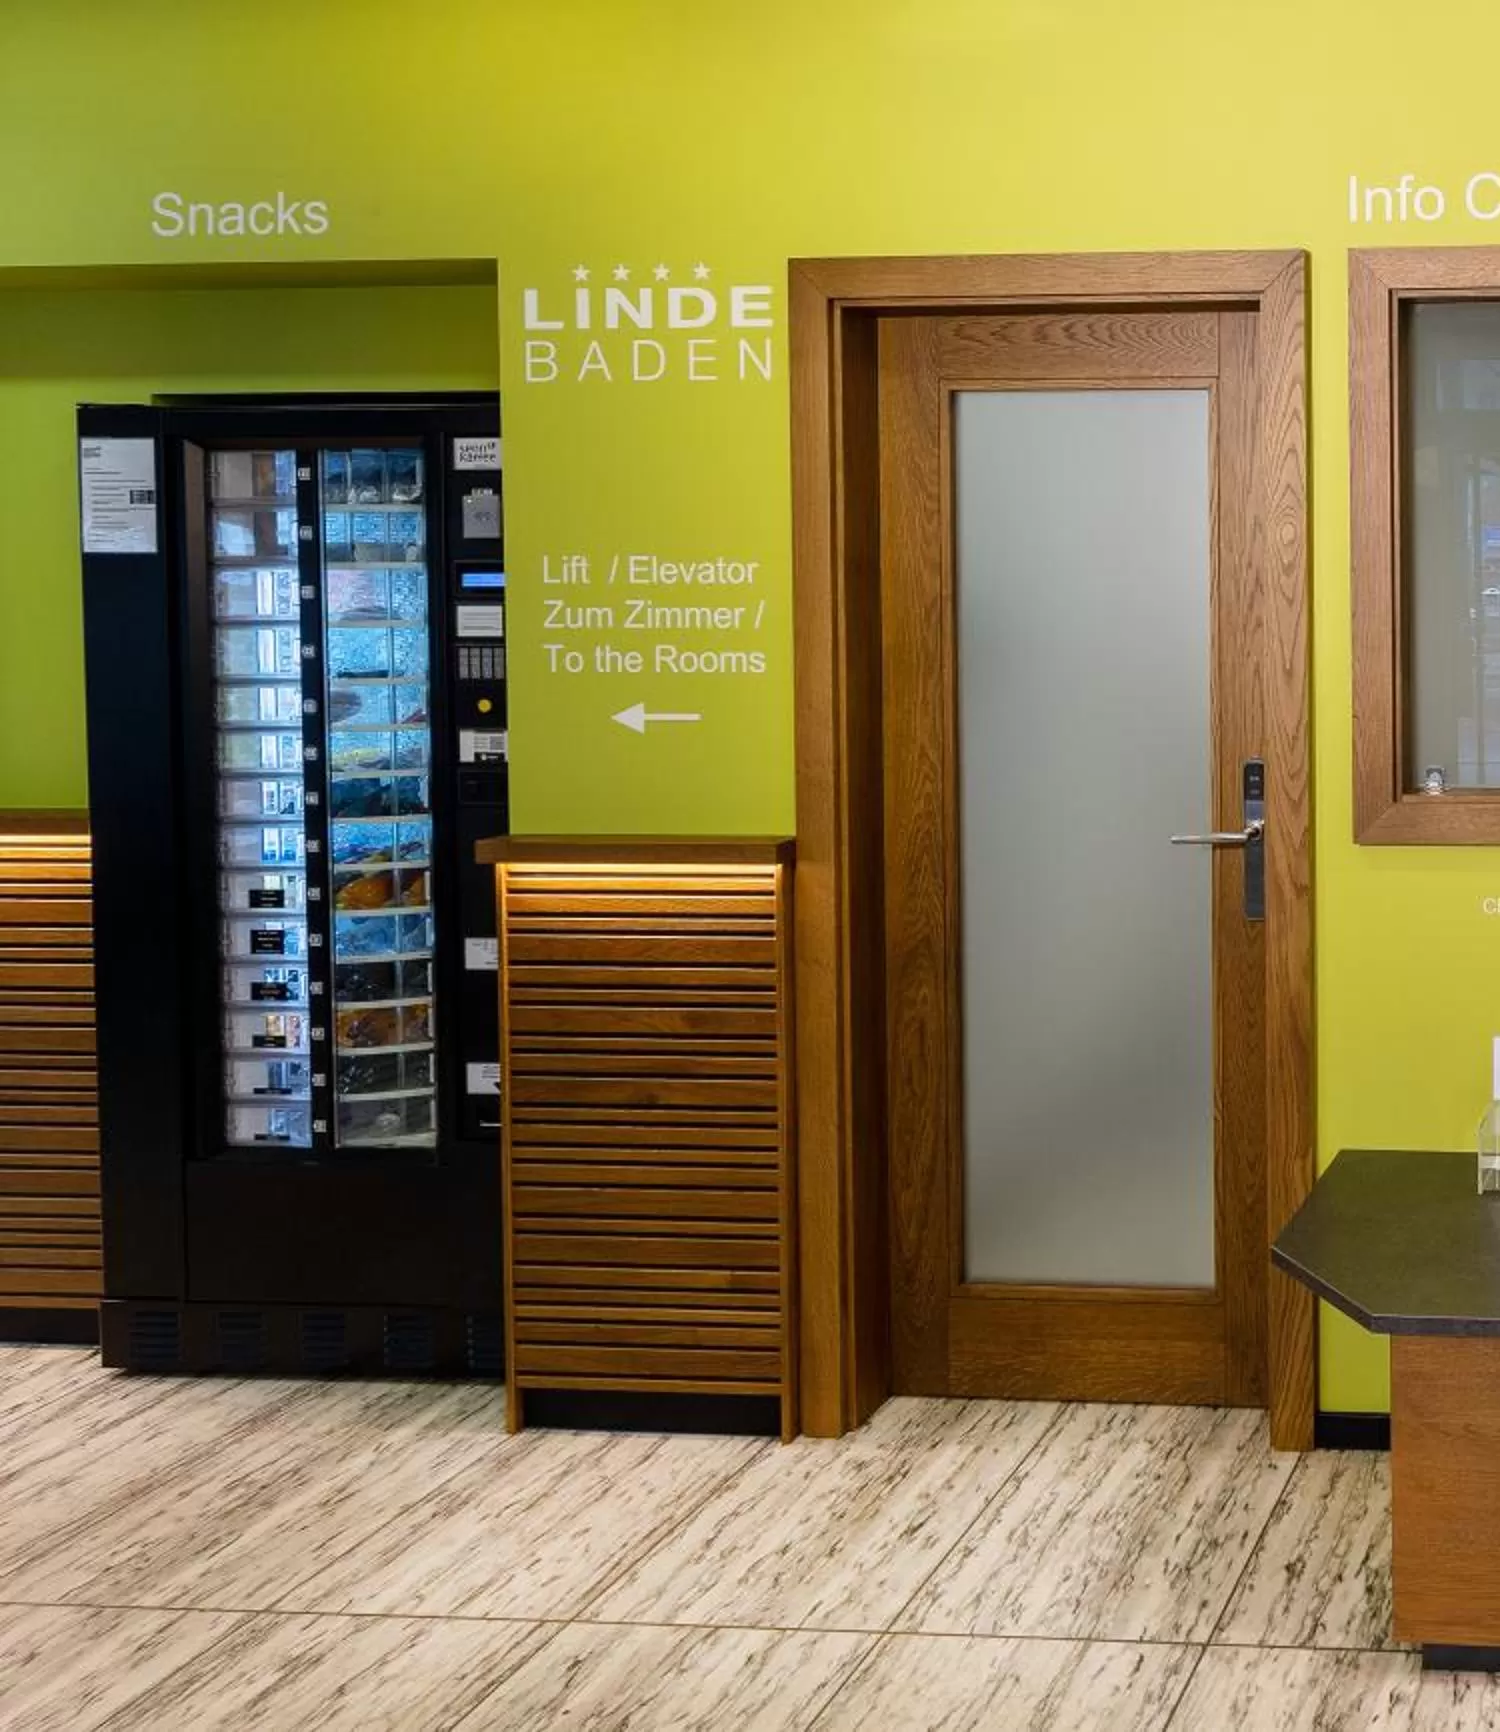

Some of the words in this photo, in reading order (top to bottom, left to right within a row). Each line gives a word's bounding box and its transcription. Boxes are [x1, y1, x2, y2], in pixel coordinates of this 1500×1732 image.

[151, 191, 329, 237] Snacks
[1349, 174, 1445, 224] Info
[524, 285, 773, 330] LINDE
[525, 337, 772, 383] BADEN
[543, 555, 590, 584] Lift
[608, 555, 618, 584] /
[628, 555, 758, 584] Elevator
[543, 600, 613, 629] Zum
[624, 600, 745, 629] Zimmer
[754, 600, 765, 630] /
[543, 644, 584, 673] To
[595, 645, 643, 673] the
[655, 644, 765, 673] Rooms
